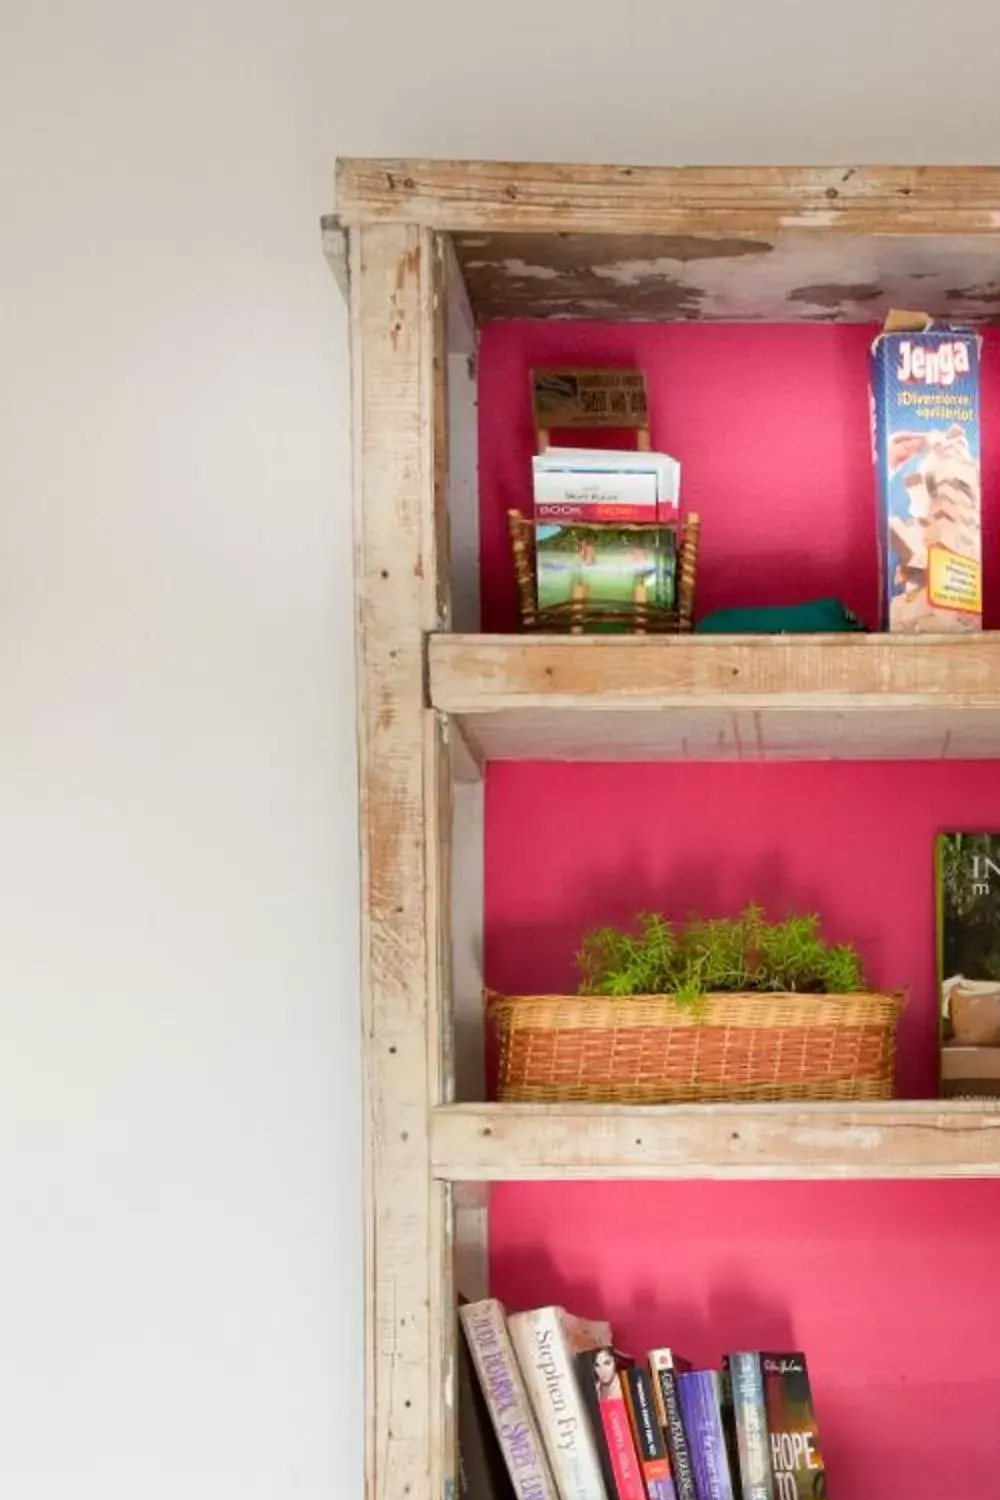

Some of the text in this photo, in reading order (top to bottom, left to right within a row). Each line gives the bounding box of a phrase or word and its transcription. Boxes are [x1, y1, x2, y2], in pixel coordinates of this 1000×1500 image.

[897, 341, 970, 386] Jenga
[533, 1329, 580, 1450] Stephen Fry
[770, 1432, 817, 1471] HOPE
